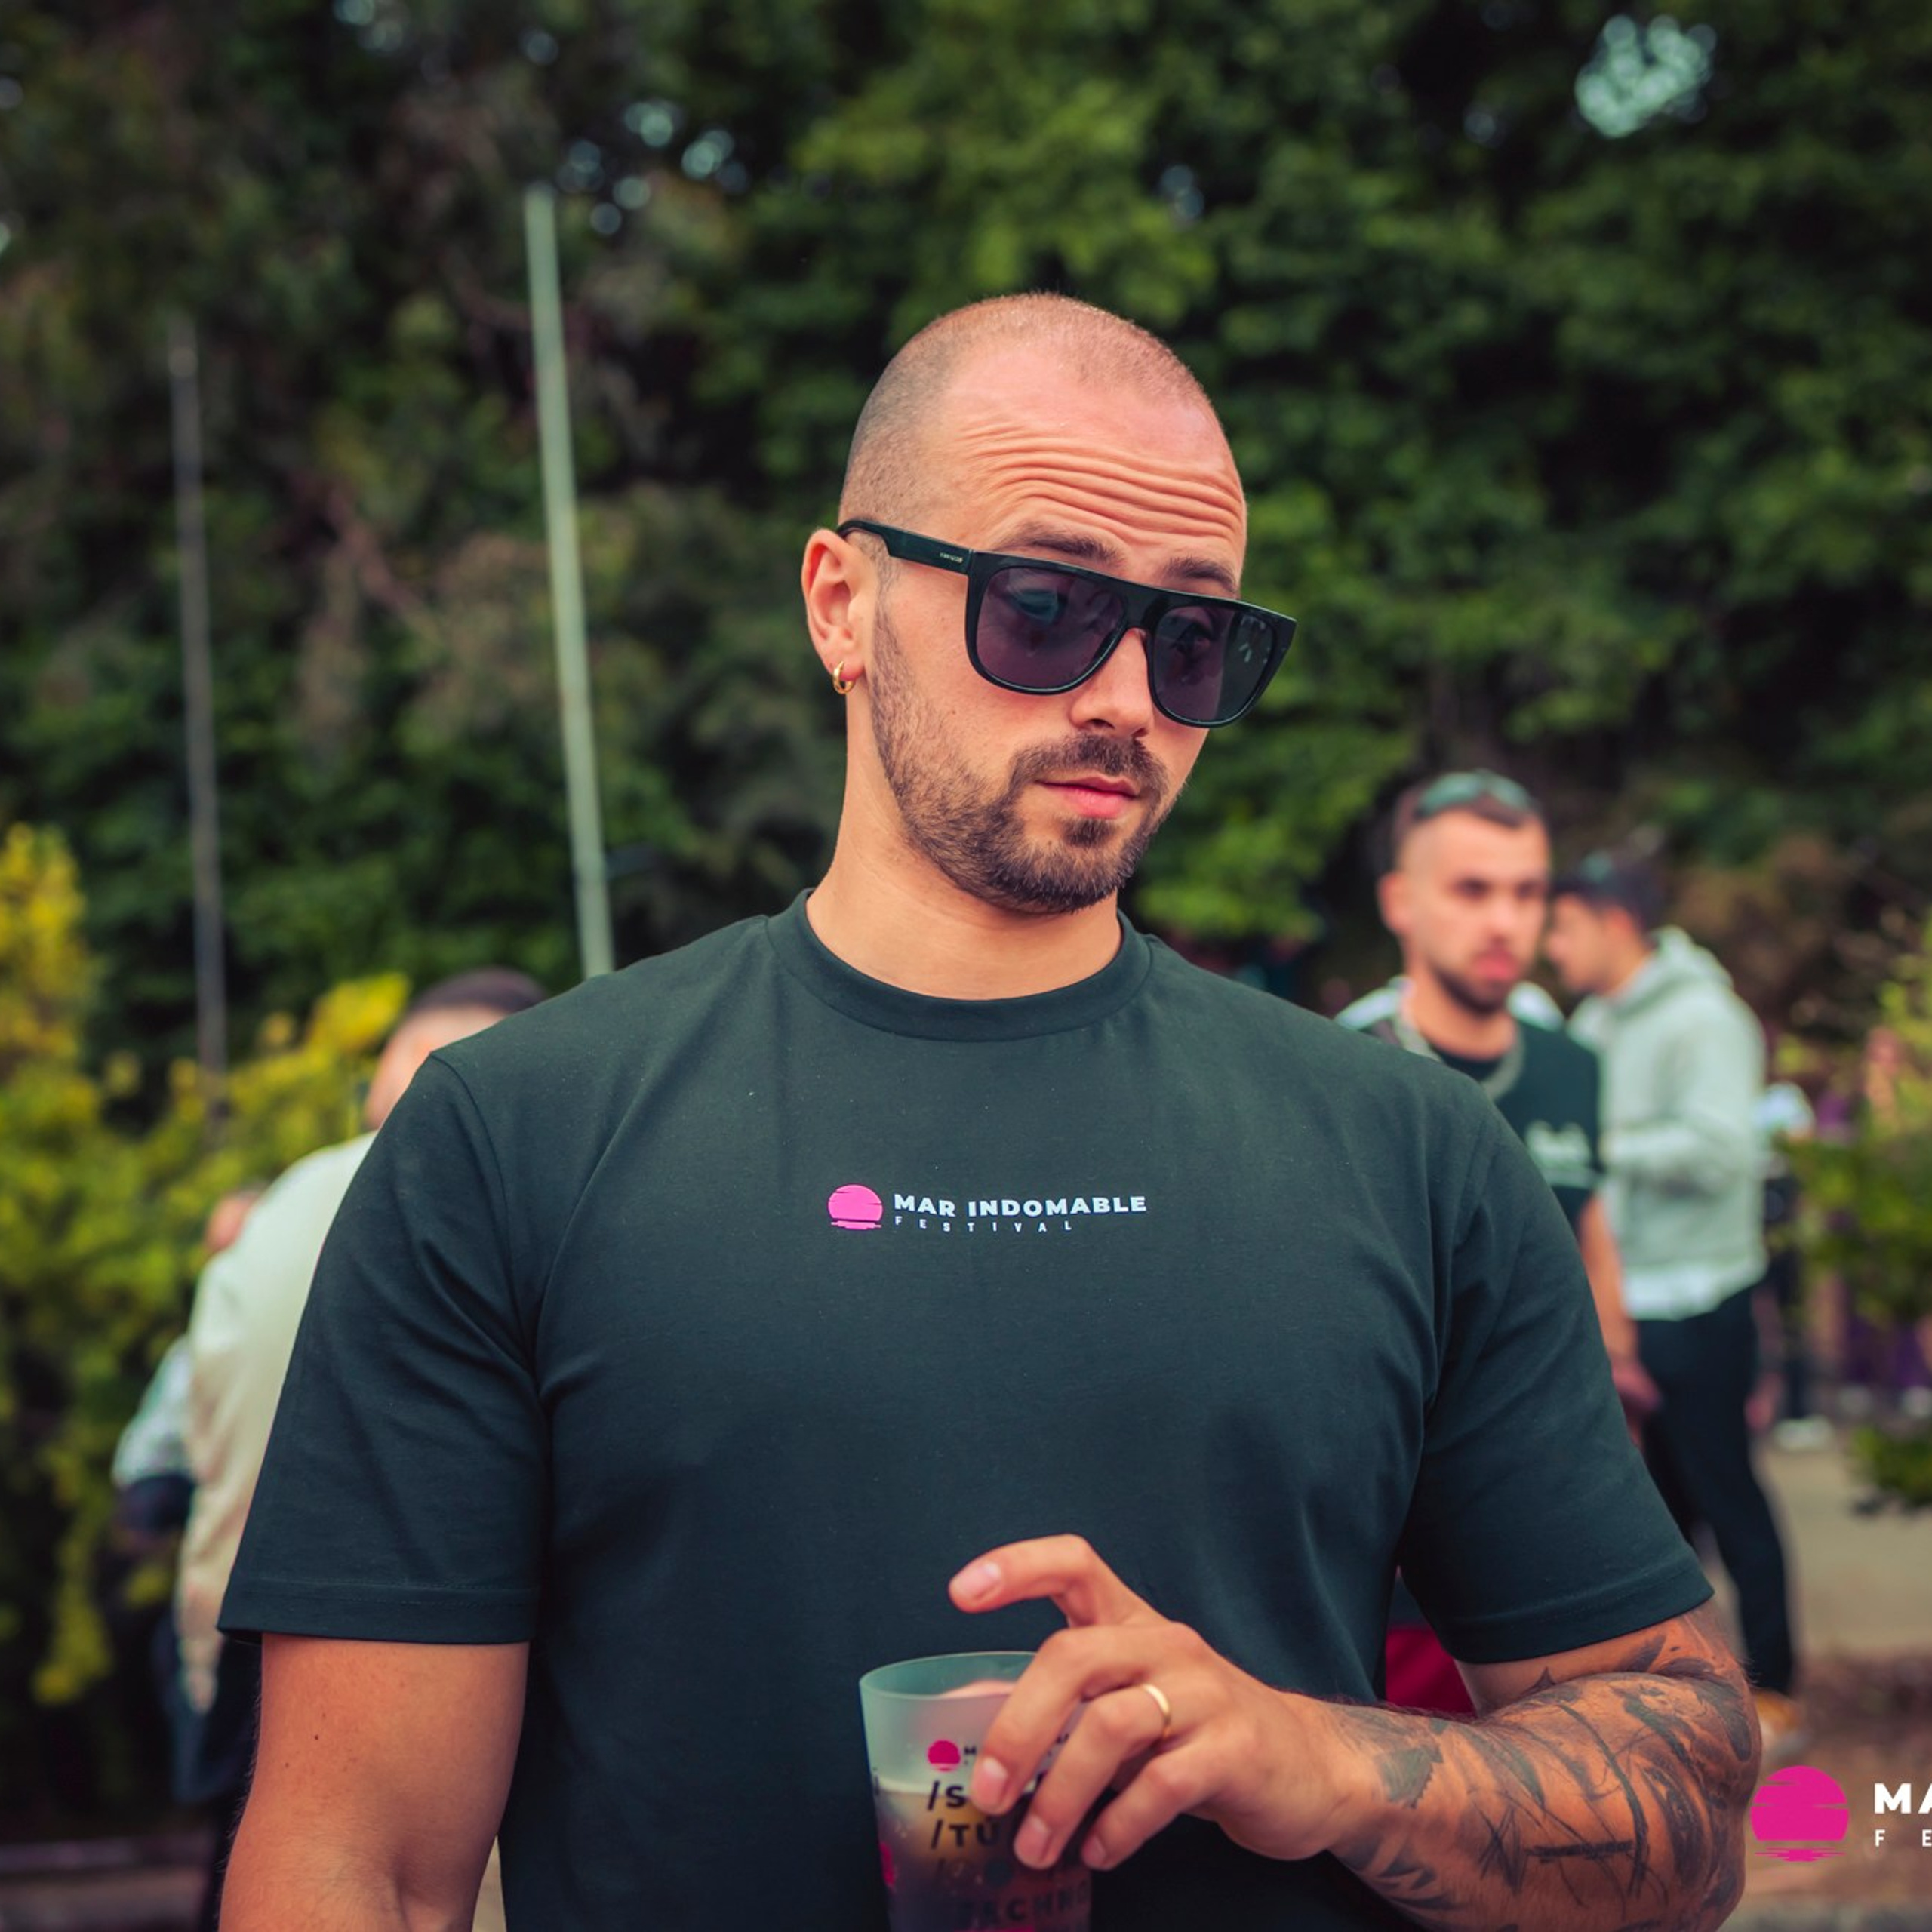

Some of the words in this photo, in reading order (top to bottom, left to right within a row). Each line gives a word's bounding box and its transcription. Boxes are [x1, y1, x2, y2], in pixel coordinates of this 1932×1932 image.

[894, 1193, 956, 1217] MAR
[968, 1195, 1147, 1217] INDOMABLE
[894, 1216, 1072, 1232] FESTIVAL
